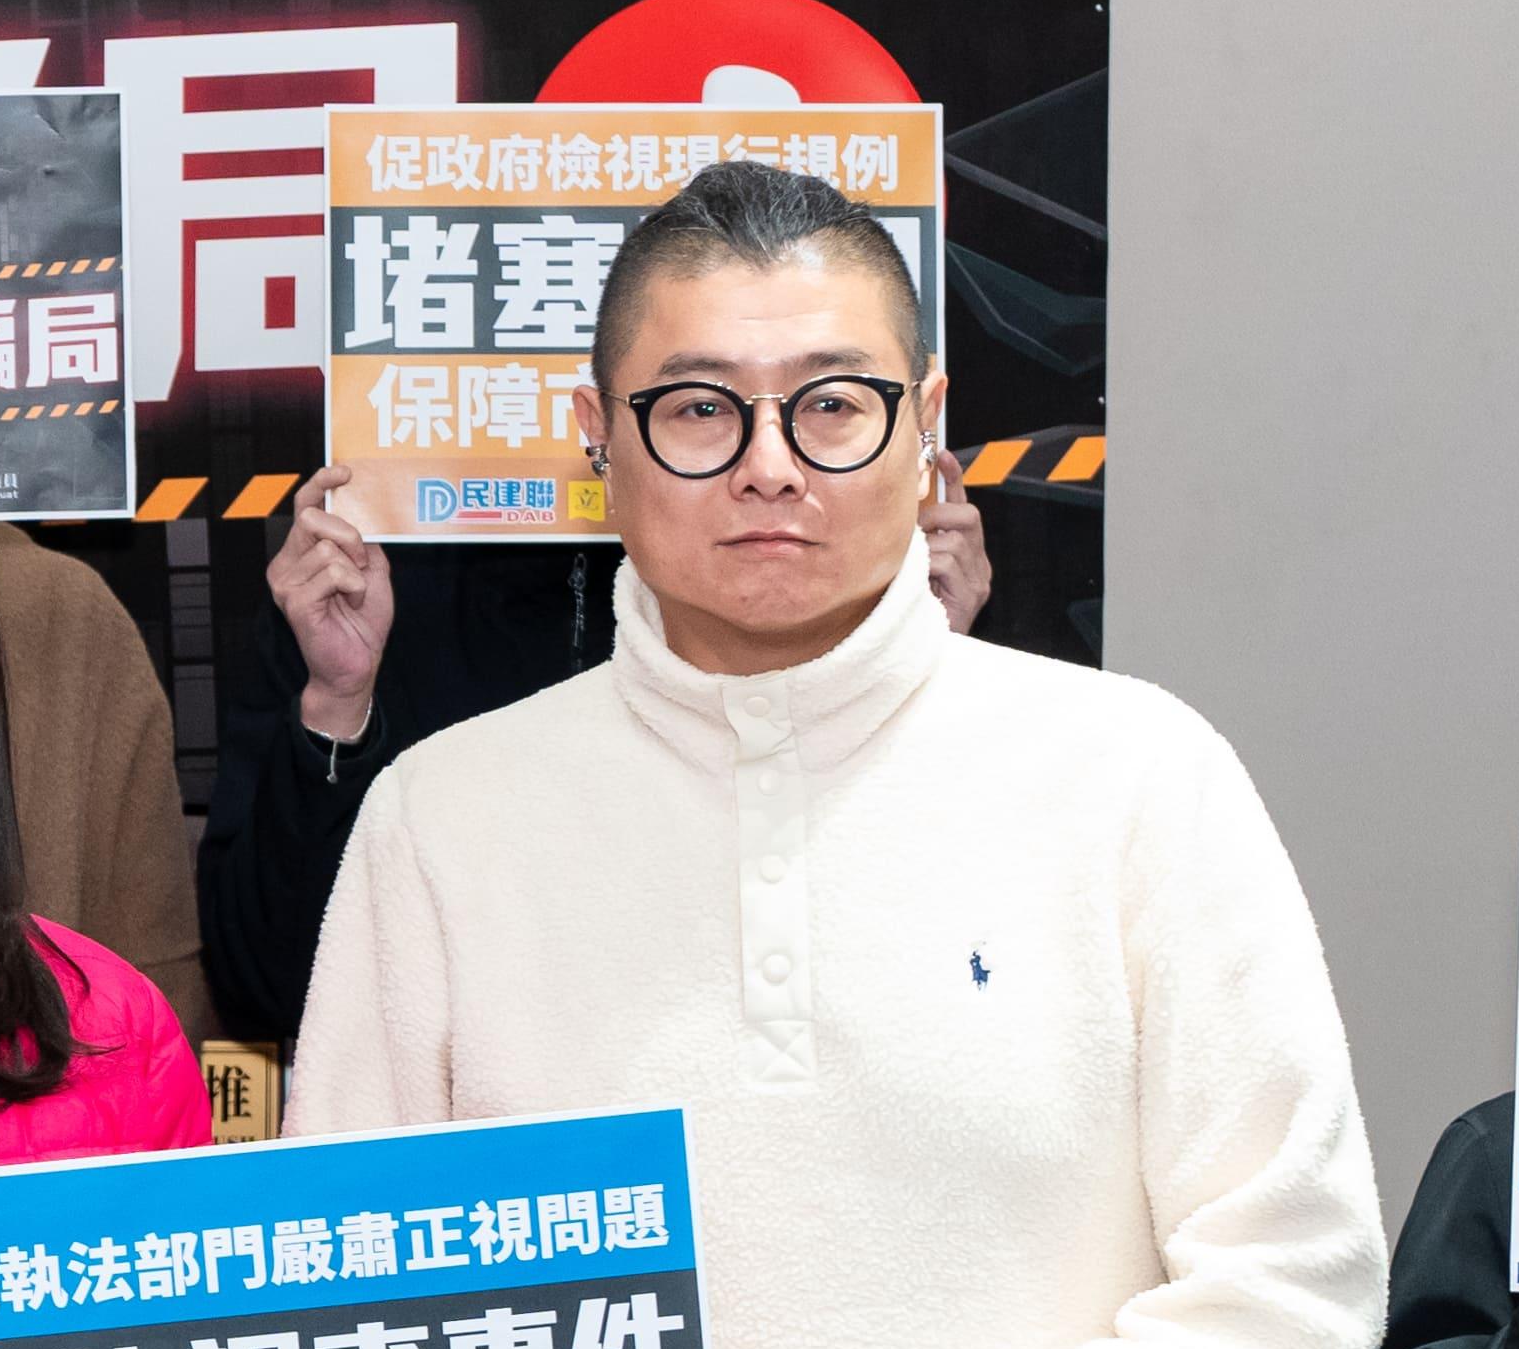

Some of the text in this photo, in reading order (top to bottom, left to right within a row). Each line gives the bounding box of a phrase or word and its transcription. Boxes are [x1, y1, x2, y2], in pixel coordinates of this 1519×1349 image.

[463, 480, 555, 508] 民建聯
[506, 511, 554, 522] DAB
